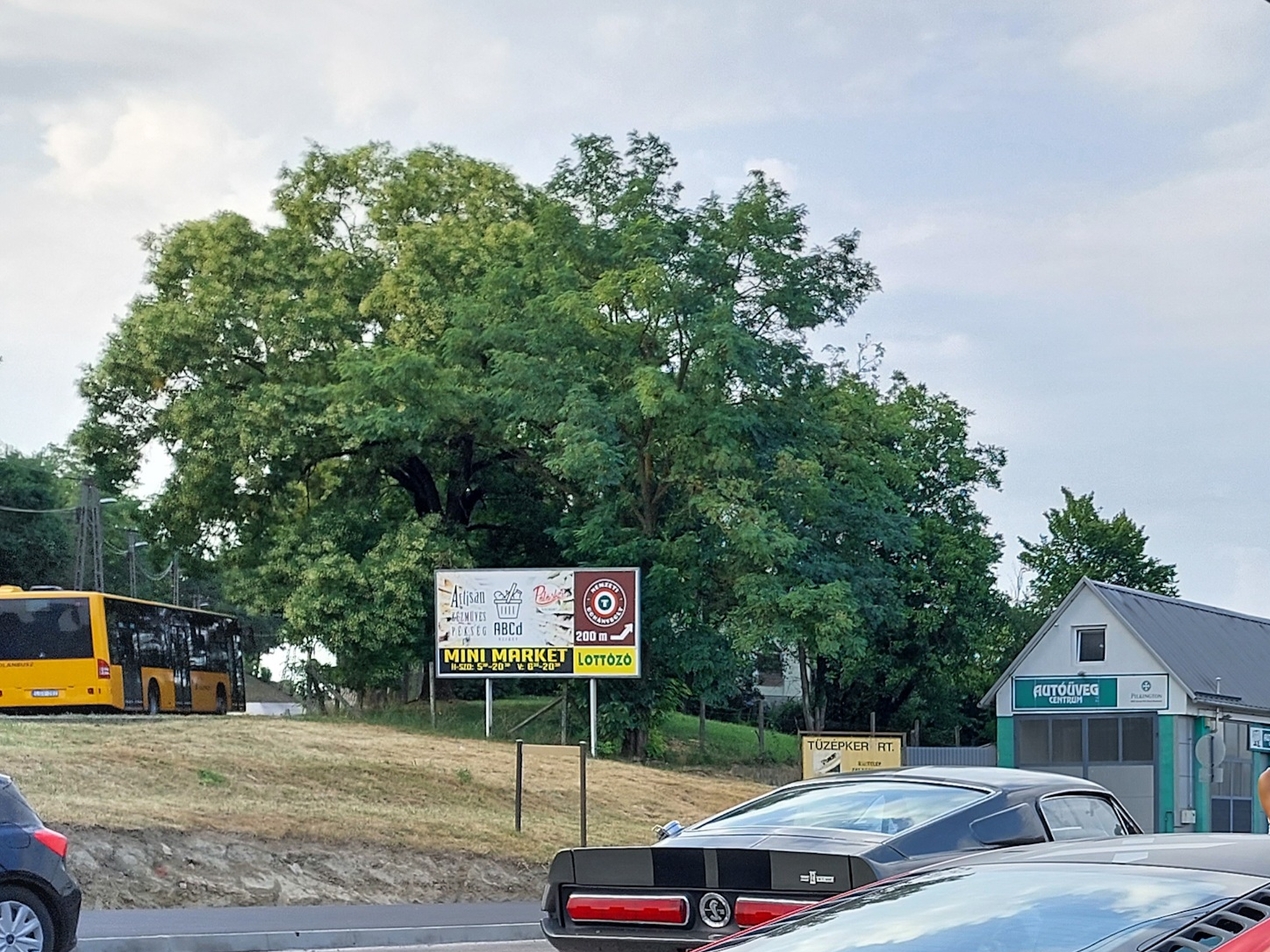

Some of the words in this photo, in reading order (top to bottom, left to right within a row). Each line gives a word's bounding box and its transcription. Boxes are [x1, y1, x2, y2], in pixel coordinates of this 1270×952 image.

[575, 631, 597, 641] 200
[598, 632, 608, 641] m
[444, 648, 486, 663] MINI
[491, 648, 568, 663] MARKET
[1048, 696, 1083, 704] CENTRUM
[877, 742, 895, 752] RT.
